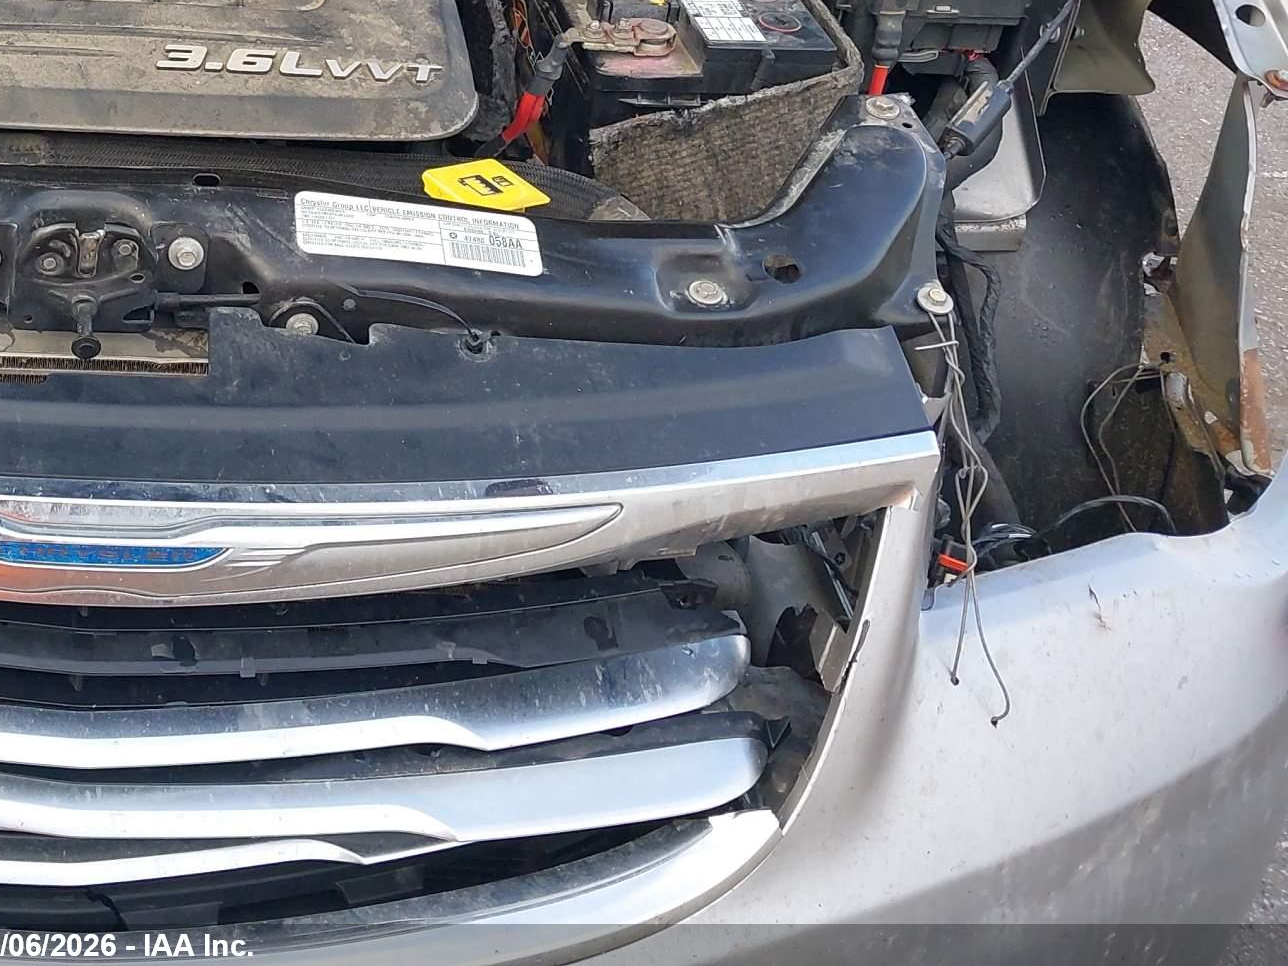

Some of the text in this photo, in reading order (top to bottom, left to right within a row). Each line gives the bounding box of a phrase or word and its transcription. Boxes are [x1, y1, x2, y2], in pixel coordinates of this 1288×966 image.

[300, 197, 330, 207] Chrysler
[332, 201, 354, 211] Group
[356, 204, 369, 212] LLC
[372, 206, 400, 215] VEHICLE
[402, 210, 436, 219] EMISSION
[471, 218, 520, 230] INFORMATION
[488, 234, 523, 250] 058AA
